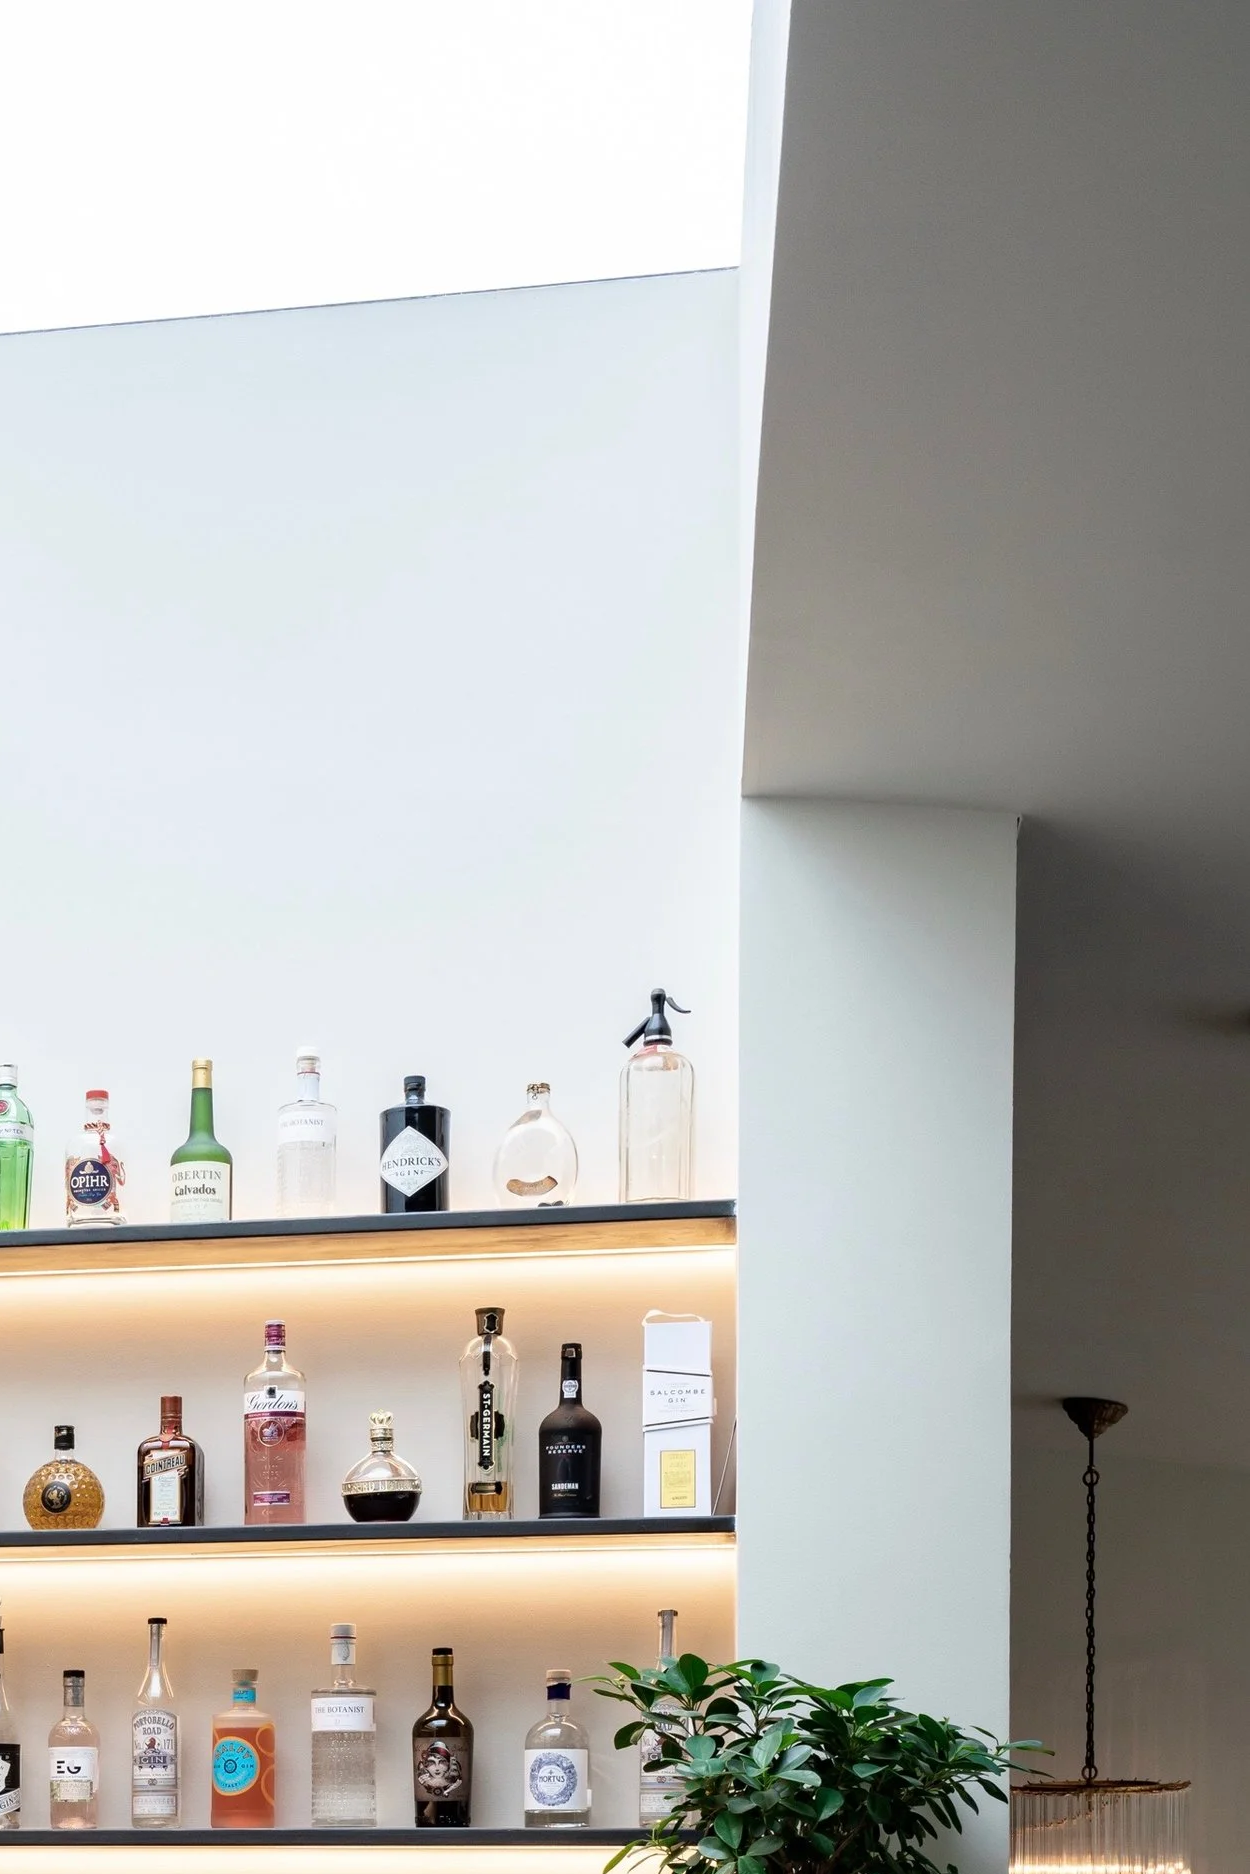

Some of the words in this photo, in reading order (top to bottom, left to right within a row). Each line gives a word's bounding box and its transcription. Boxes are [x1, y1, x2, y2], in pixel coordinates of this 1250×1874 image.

[381, 1156, 442, 1171] HENDRICK'S
[400, 1169, 419, 1177] GIN
[70, 1174, 109, 1189] OPIHR
[174, 1184, 216, 1197] Calvados
[649, 1388, 706, 1396] SALCOMBE
[482, 1393, 491, 1457] ST-GERMAIN
[145, 1453, 186, 1475] COINTREAU
[315, 1706, 326, 1714] THE
[327, 1705, 365, 1713] BOTANIST
[133, 1716, 175, 1731] PORTOBELLO
[142, 1727, 162, 1735] ROAD
[163, 1738, 175, 1750] 171
[140, 1756, 166, 1764] GIN
[0, 1798, 14, 1810] GIN
